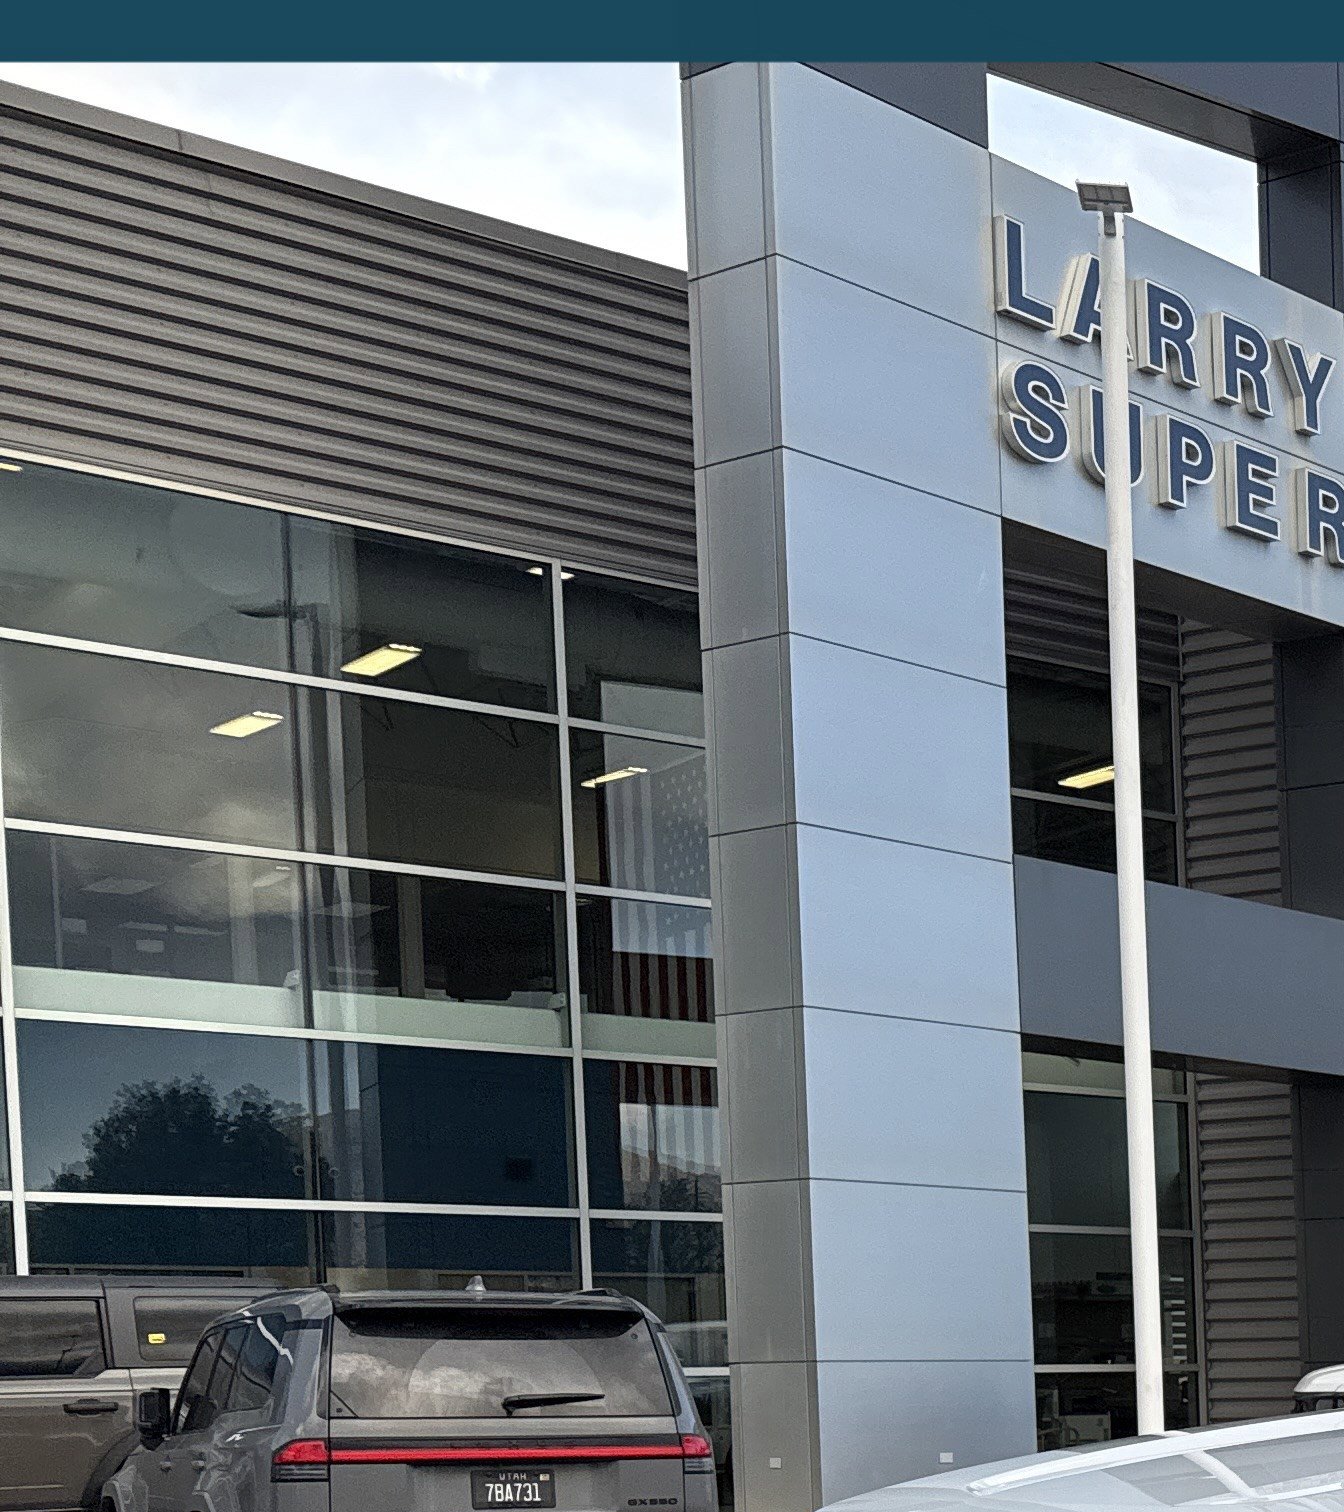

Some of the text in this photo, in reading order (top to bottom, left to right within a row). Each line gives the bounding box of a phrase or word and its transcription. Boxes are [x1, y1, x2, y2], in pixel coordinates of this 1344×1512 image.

[993, 213, 1337, 436] LARRY
[499, 1472, 528, 1481] UTAH
[484, 1482, 542, 1503] 7BA731
